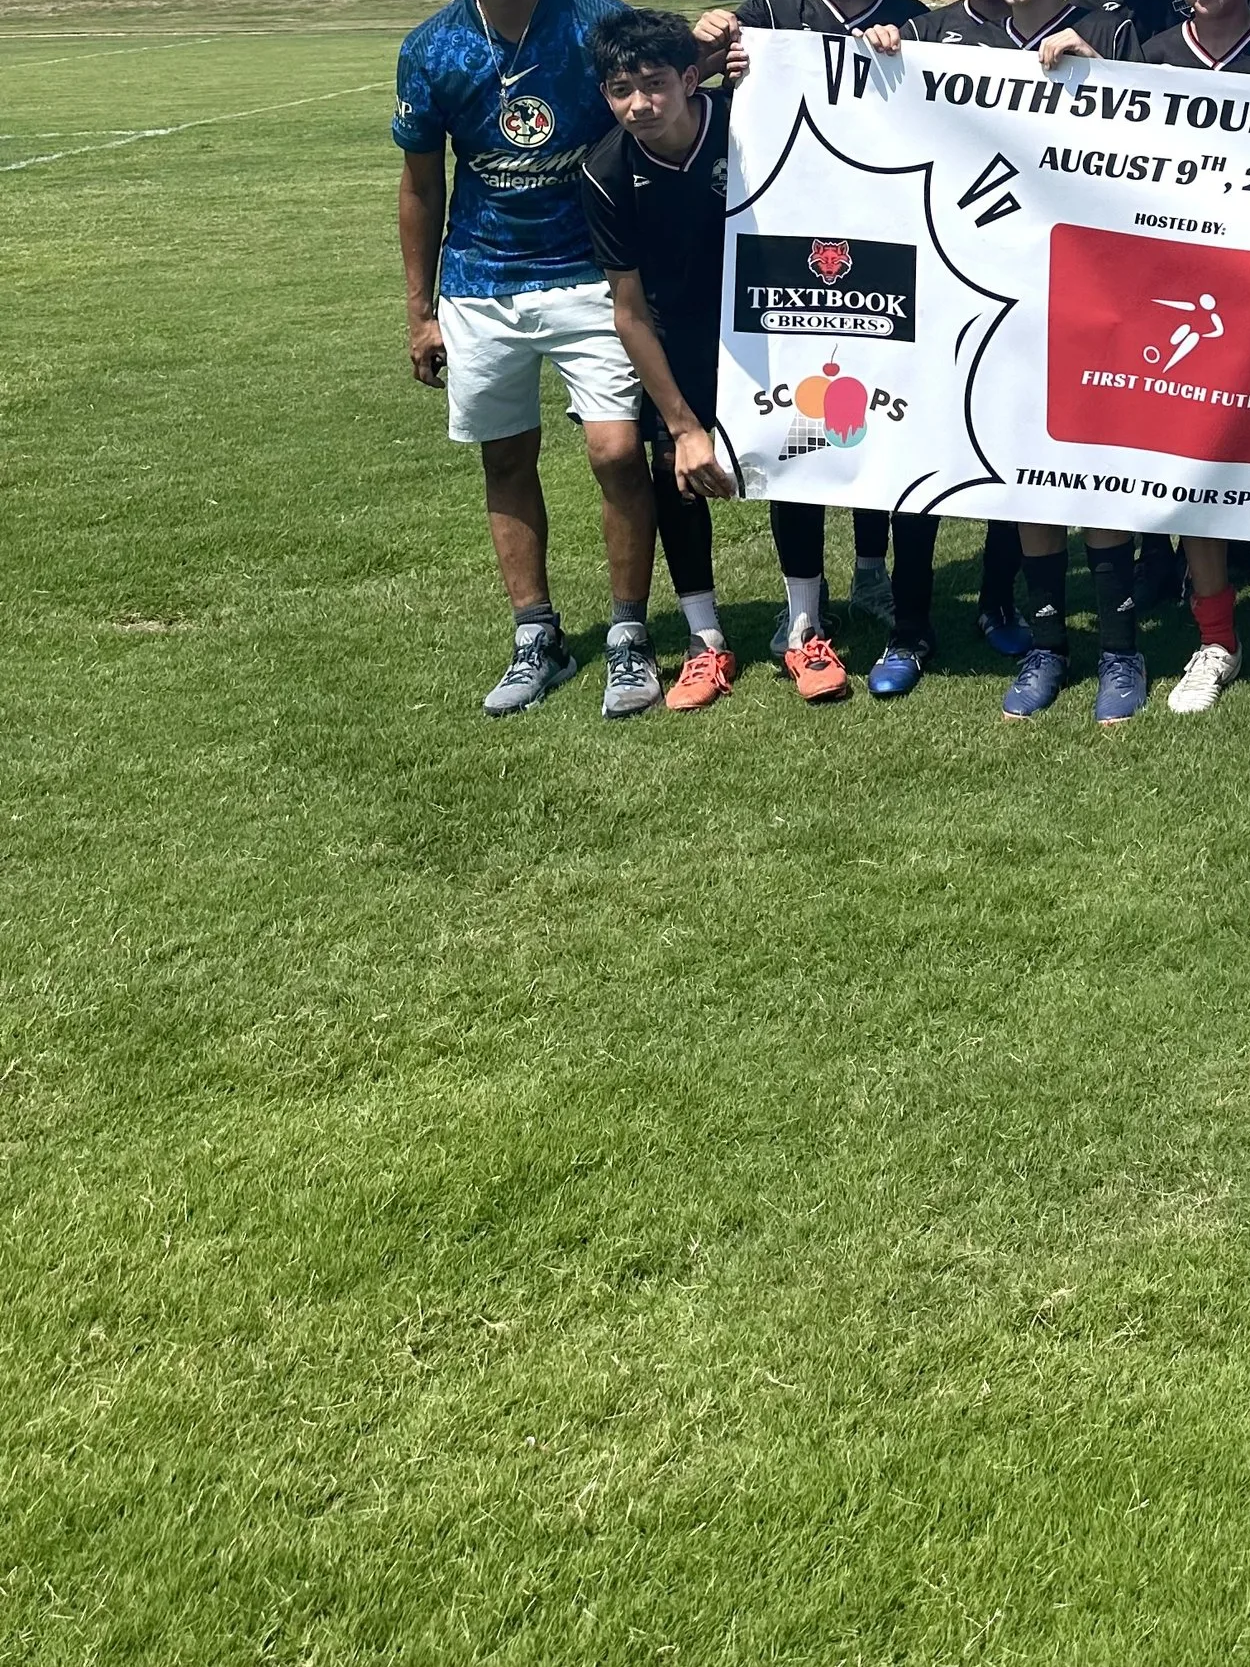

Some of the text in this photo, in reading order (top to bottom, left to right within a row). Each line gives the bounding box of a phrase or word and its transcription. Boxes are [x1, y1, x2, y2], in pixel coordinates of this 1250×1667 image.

[922, 71, 1064, 114] YOUTH
[1069, 86, 1152, 122] 5V5
[1038, 147, 1172, 182] AUGUST
[1134, 212, 1227, 236] HOSTED BY:
[747, 286, 908, 318] TEXTBOOK
[777, 314, 879, 331] BROKERS
[1082, 371, 1138, 390] FIRST
[1144, 377, 1207, 402] TOUCH
[1015, 469, 1088, 491] THANK
[1092, 474, 1136, 494] YOU
[1141, 480, 1168, 499] TO
[1172, 486, 1219, 505] OUR
